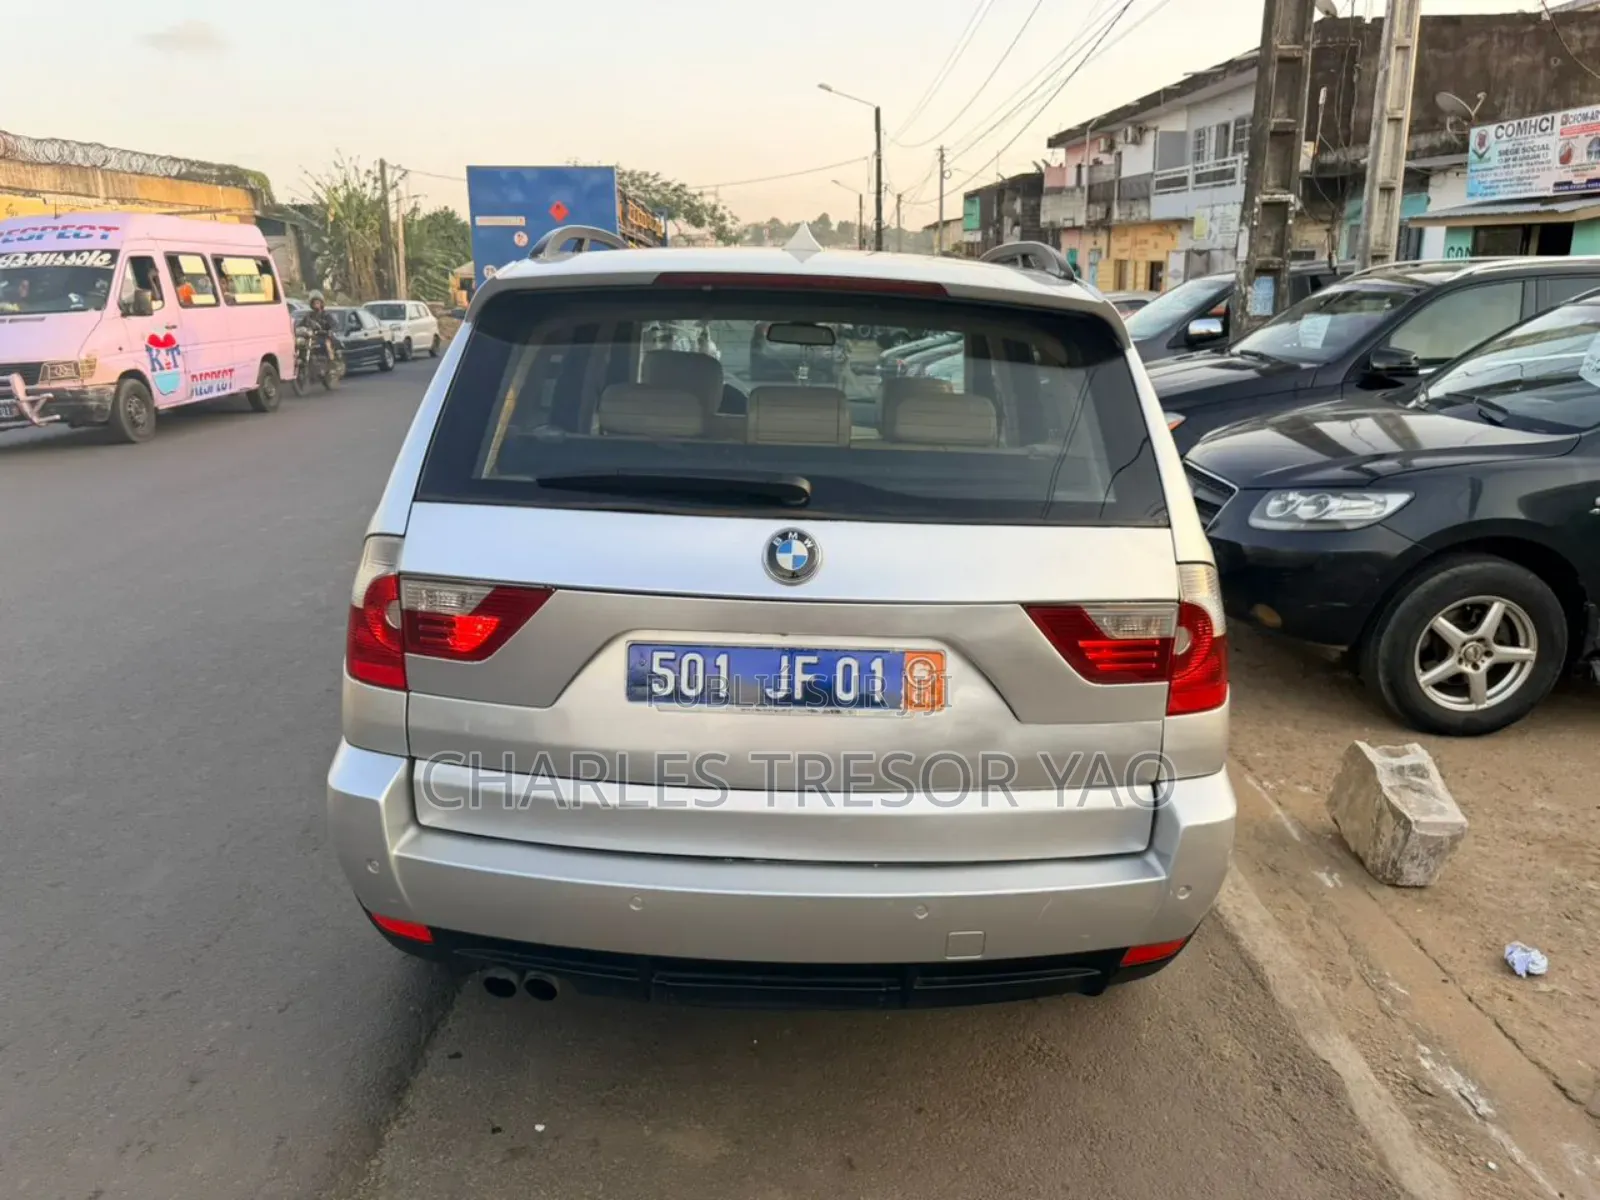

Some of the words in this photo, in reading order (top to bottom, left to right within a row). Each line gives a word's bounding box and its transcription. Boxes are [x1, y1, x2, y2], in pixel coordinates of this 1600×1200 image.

[1494, 115, 1555, 140] COMHCI
[1522, 143, 1550, 154] SOCIAL
[0, 224, 120, 244] ESPECT
[651, 650, 729, 698] 501
[765, 655, 818, 701] JF
[836, 657, 884, 703] 01
